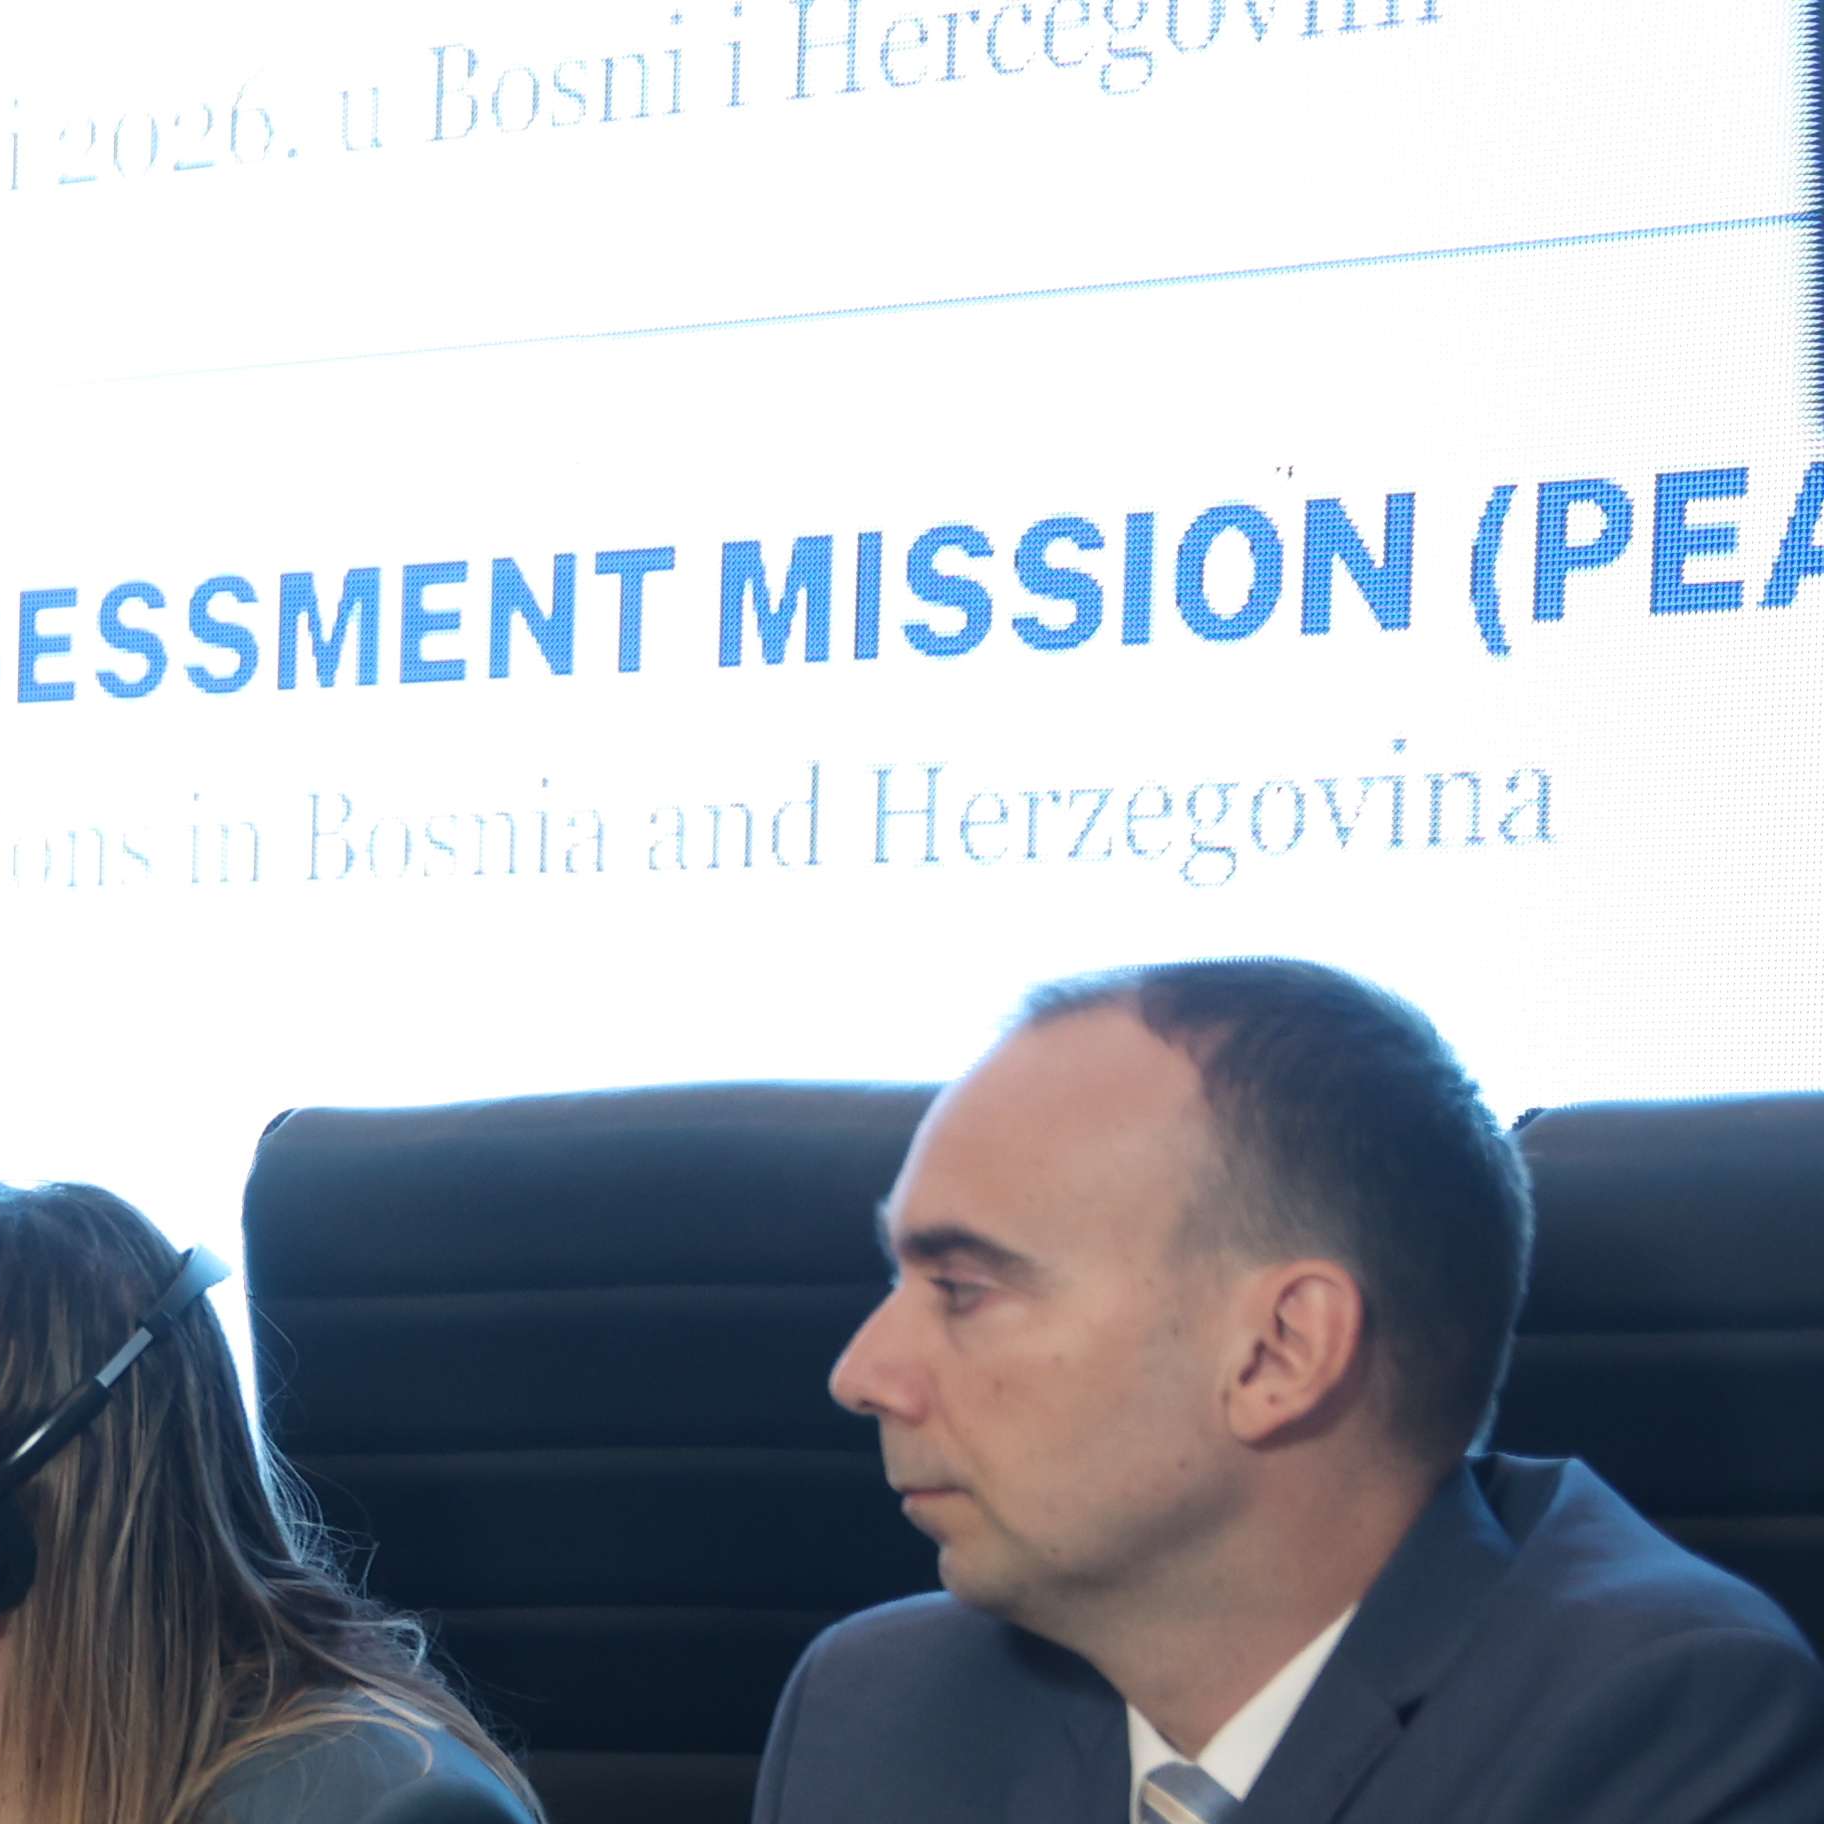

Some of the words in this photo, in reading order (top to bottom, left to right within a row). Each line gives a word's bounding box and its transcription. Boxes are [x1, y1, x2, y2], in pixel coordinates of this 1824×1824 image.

[337, 77, 384, 154] u
[424, 6, 687, 144] Bosni
[724, 0, 750, 110] i
[717, 492, 1417, 670] MISSION
[189, 792, 262, 885] in
[305, 777, 607, 881] Bosnia
[646, 759, 824, 872] and
[871, 737, 1557, 888] Herzegovina
